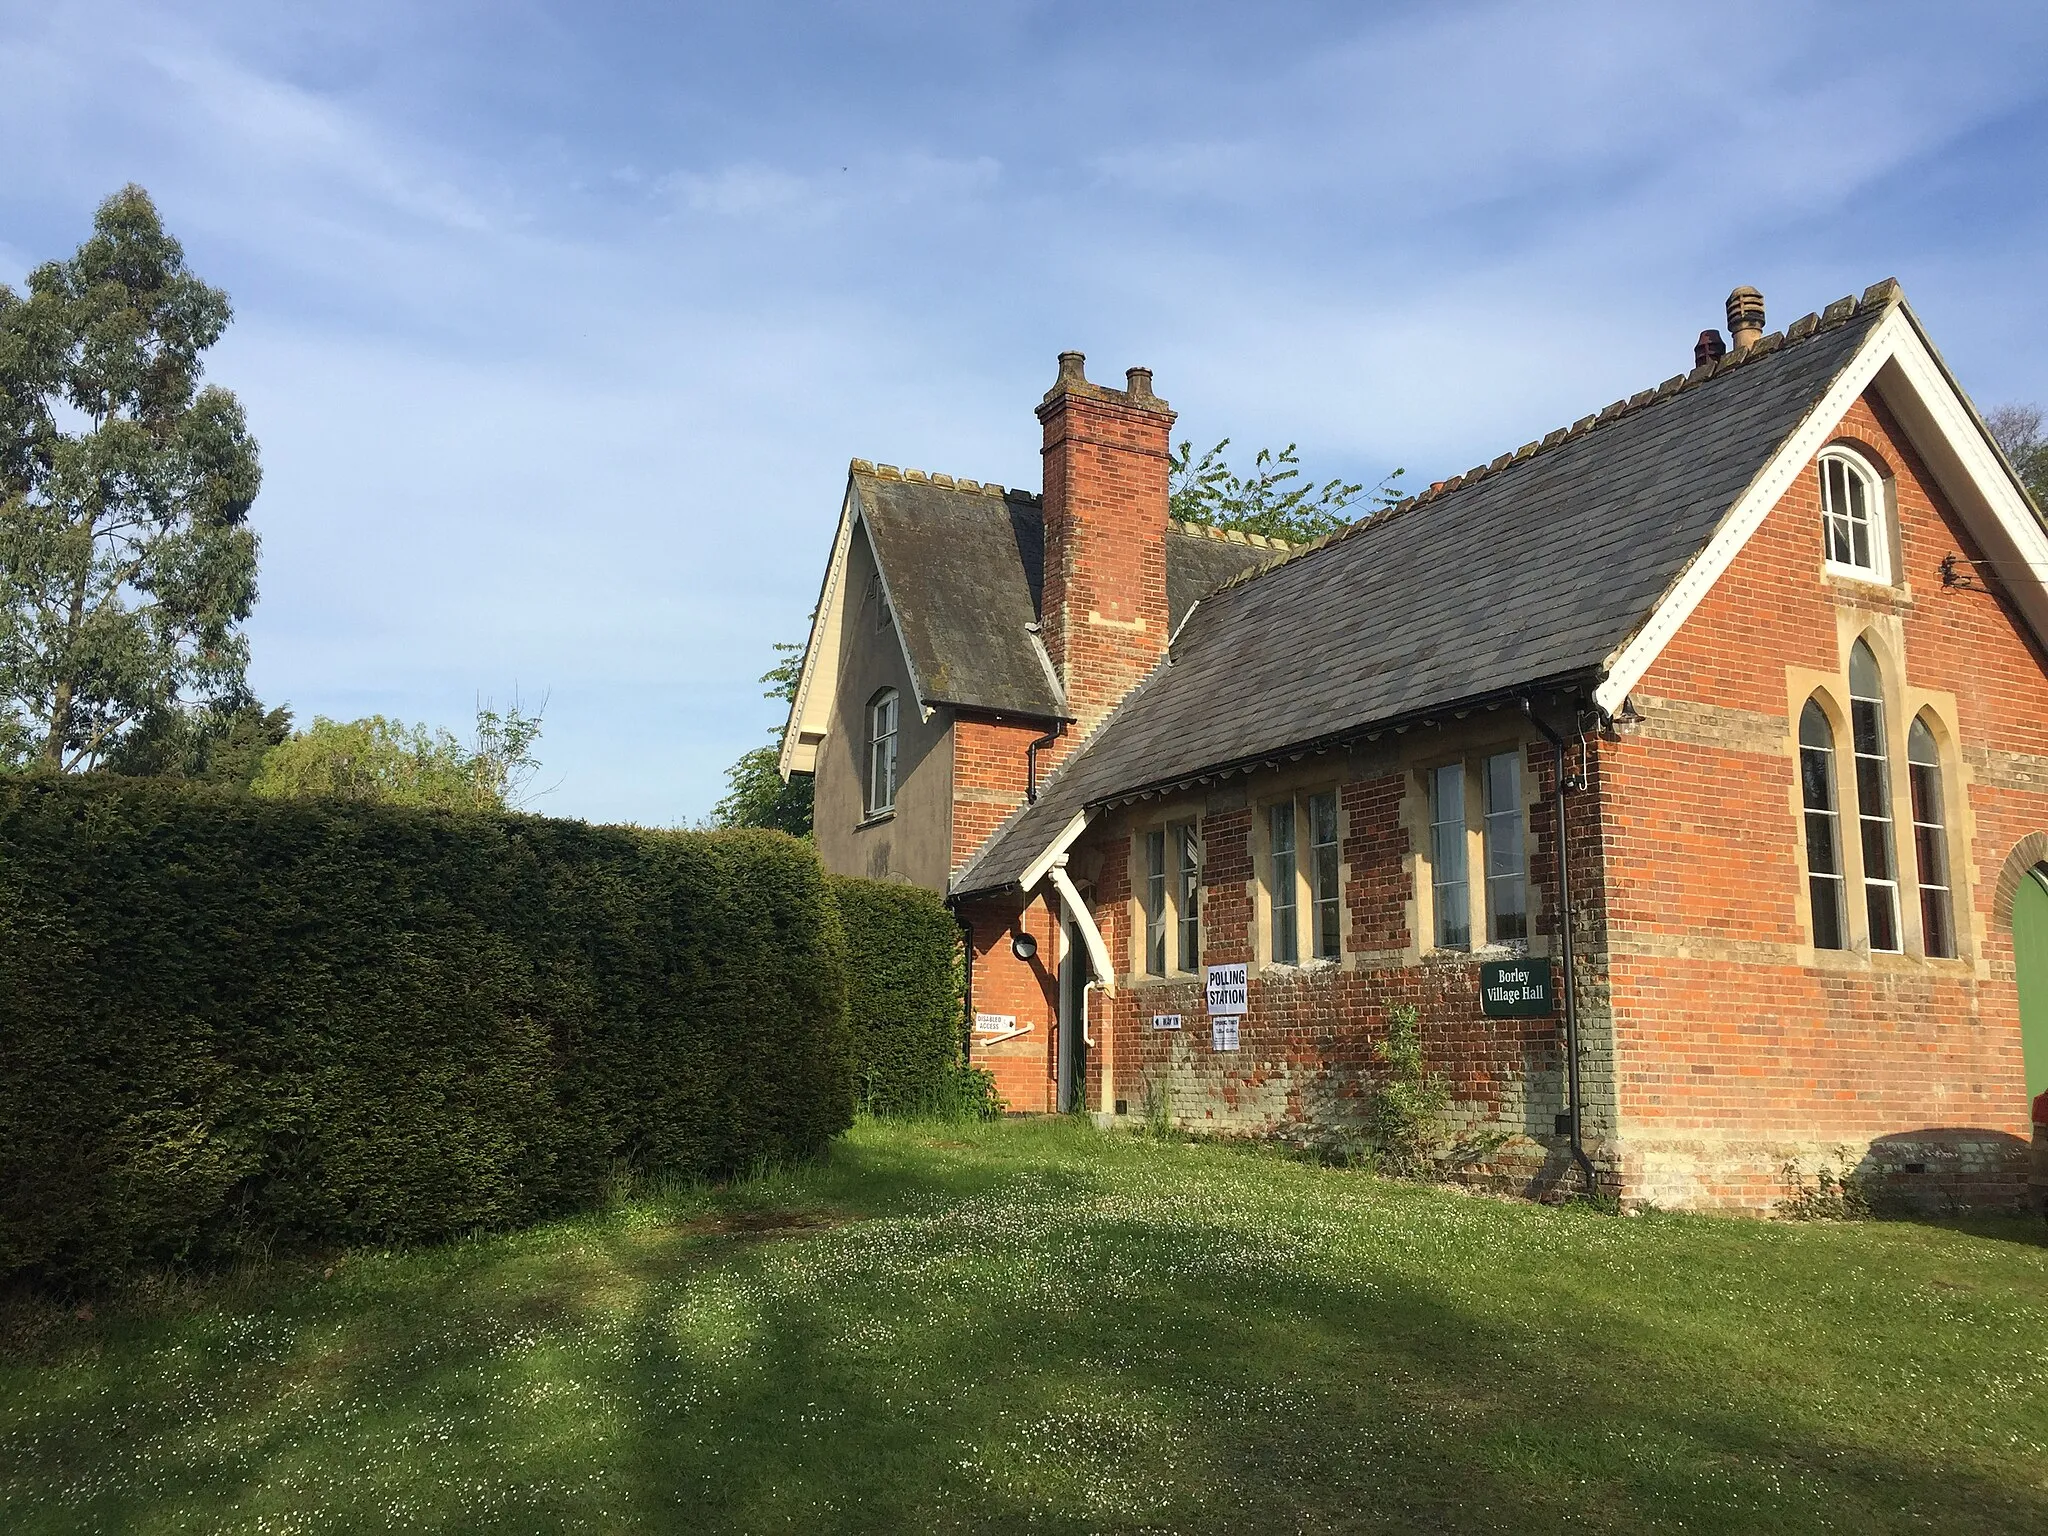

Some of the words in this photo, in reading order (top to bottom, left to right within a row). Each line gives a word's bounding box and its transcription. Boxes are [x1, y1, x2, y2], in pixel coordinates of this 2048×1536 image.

[1209, 969, 1245, 986] POLLING
[1498, 967, 1530, 985] Borley
[1209, 989, 1245, 1005] STATION
[1487, 986, 1520, 1004] Village
[1522, 984, 1544, 1000] Hall
[977, 1015, 1002, 1023] DISABLED
[979, 1022, 1000, 1030] ACCESS
